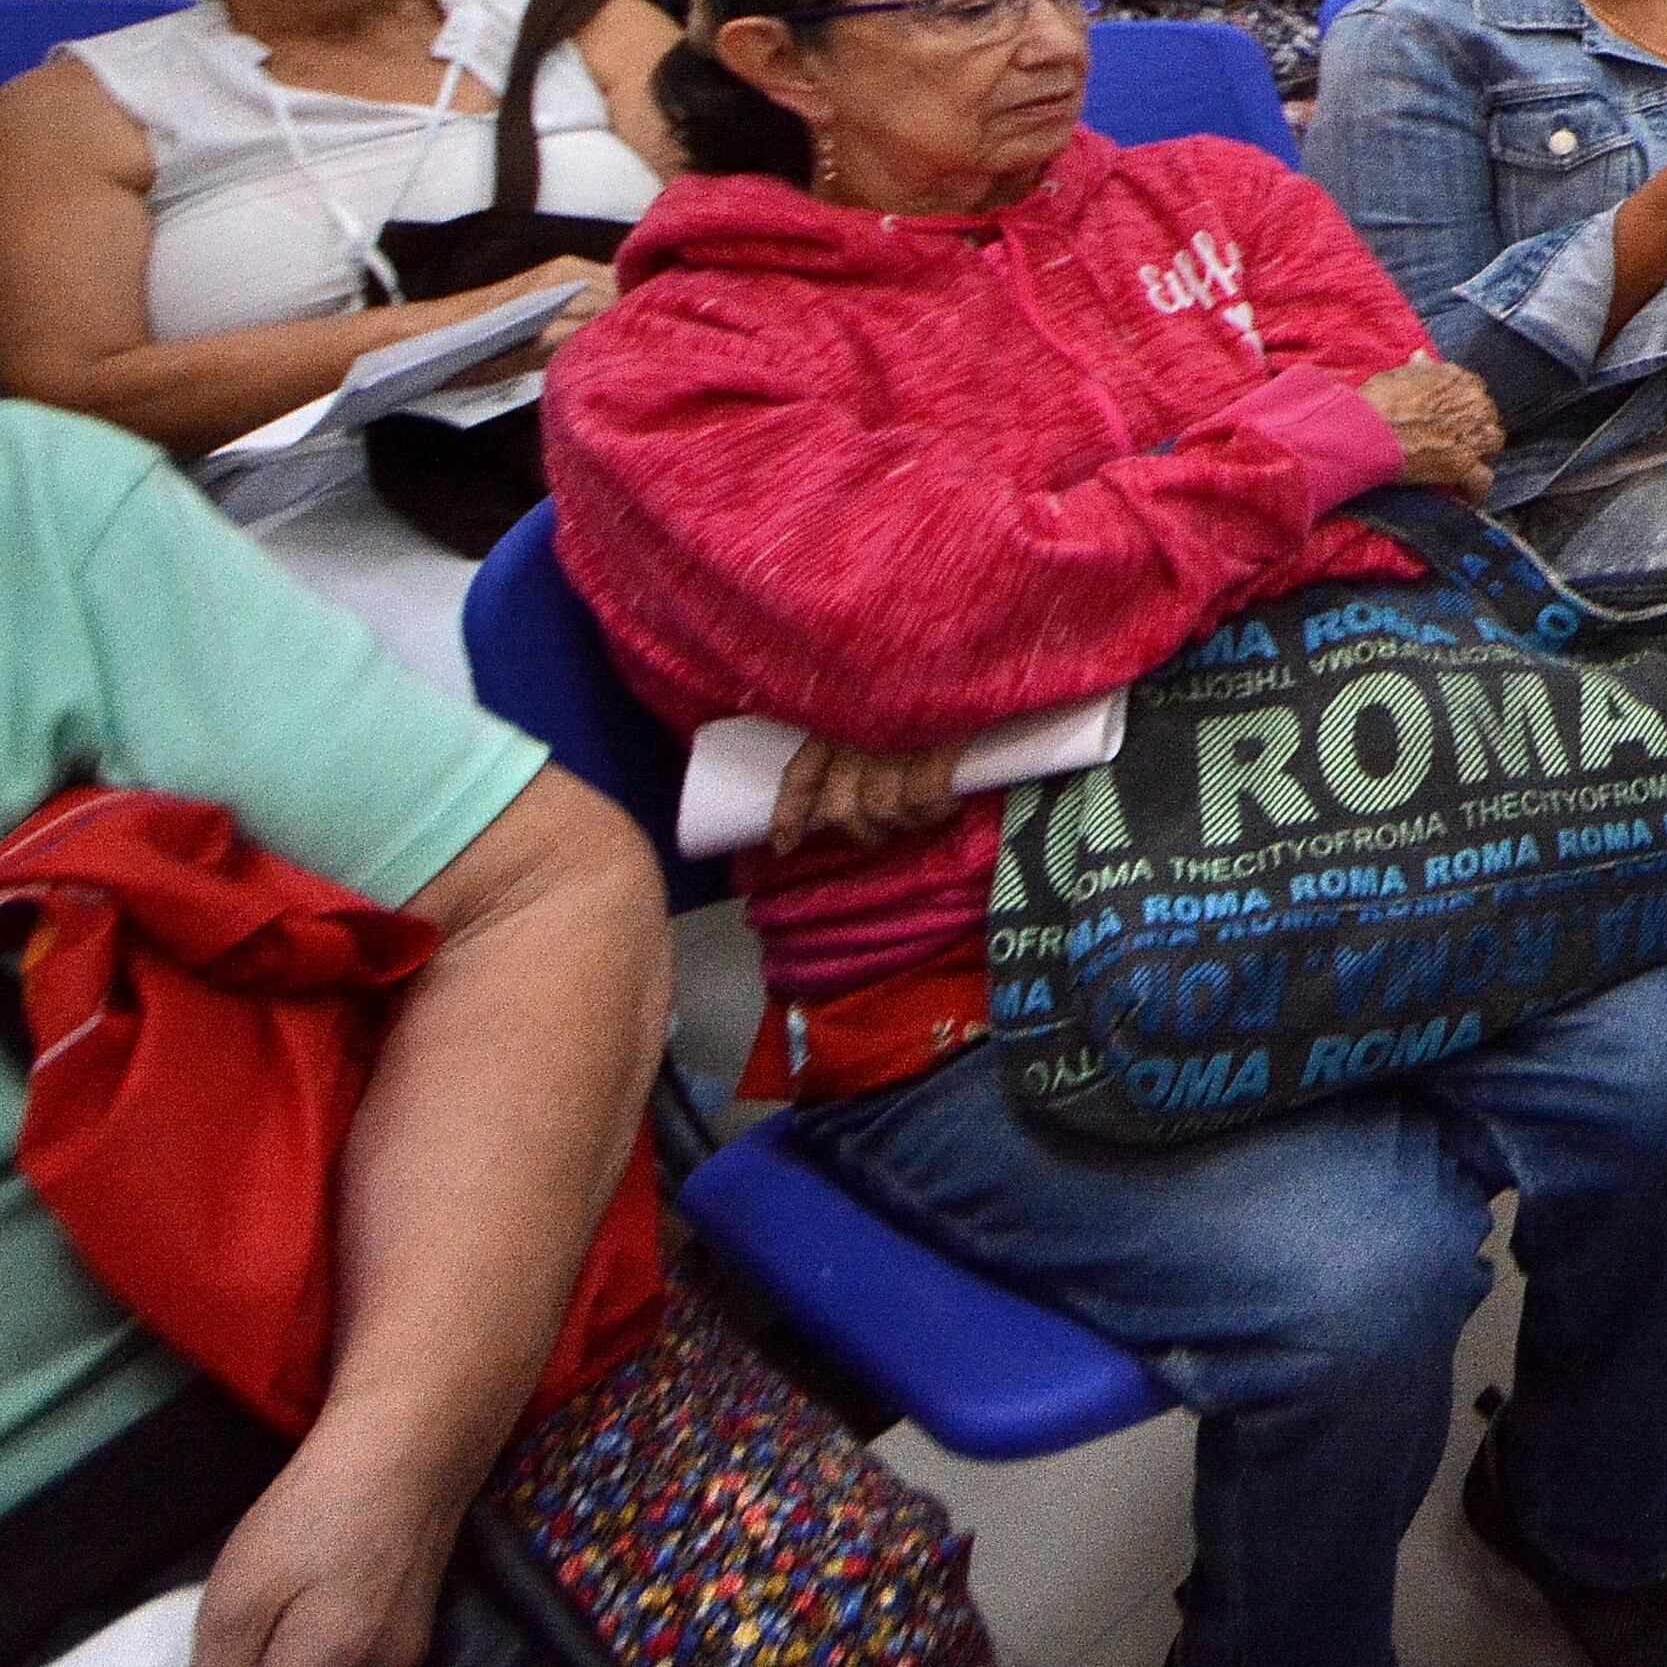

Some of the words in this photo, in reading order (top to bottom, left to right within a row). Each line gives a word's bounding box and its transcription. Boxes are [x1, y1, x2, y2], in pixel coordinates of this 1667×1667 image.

[1142, 887, 1273, 926] ROMA
[1290, 864, 1408, 905] ROMA
[1425, 833, 1541, 889] ROMA
[1557, 818, 1653, 861] ROMA
[1170, 811, 1448, 883] THECITYOFROMA
[1301, 1012, 1482, 1087] ROMA
